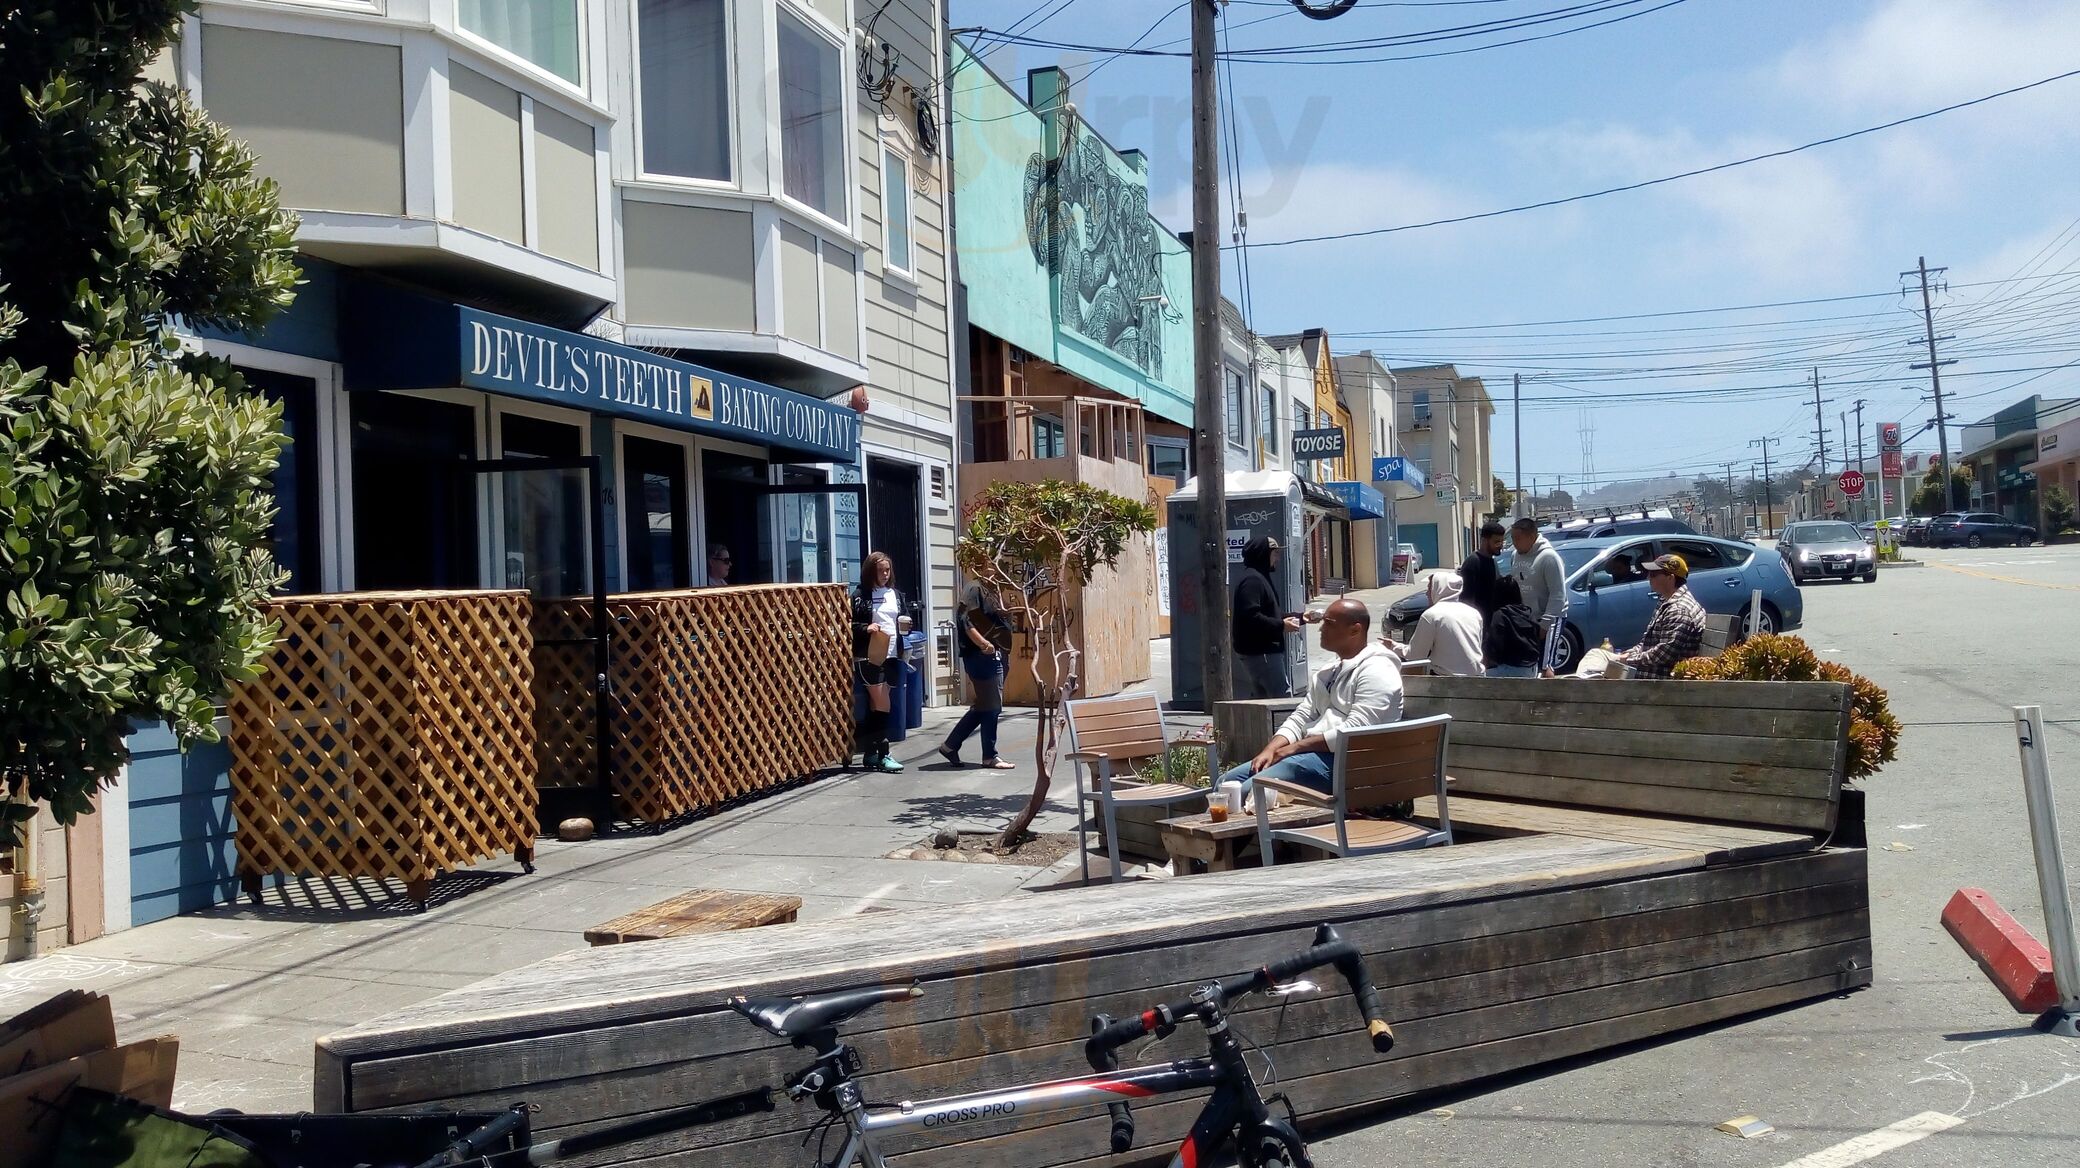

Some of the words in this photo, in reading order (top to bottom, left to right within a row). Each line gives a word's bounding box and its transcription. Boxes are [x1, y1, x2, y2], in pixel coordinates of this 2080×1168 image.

[469, 320, 590, 395] DEVIL'S
[595, 350, 682, 415] TEETH
[719, 381, 782, 436] BAKING
[785, 399, 852, 452] COMPANY
[1294, 434, 1342, 453] TOYOSE
[1886, 428, 1898, 441] 76
[1378, 459, 1402, 481] spa
[1839, 477, 1863, 488] STOP
[1226, 536, 1245, 546] ted
[923, 1106, 978, 1127] CROSS
[982, 1100, 1016, 1118] PRO
